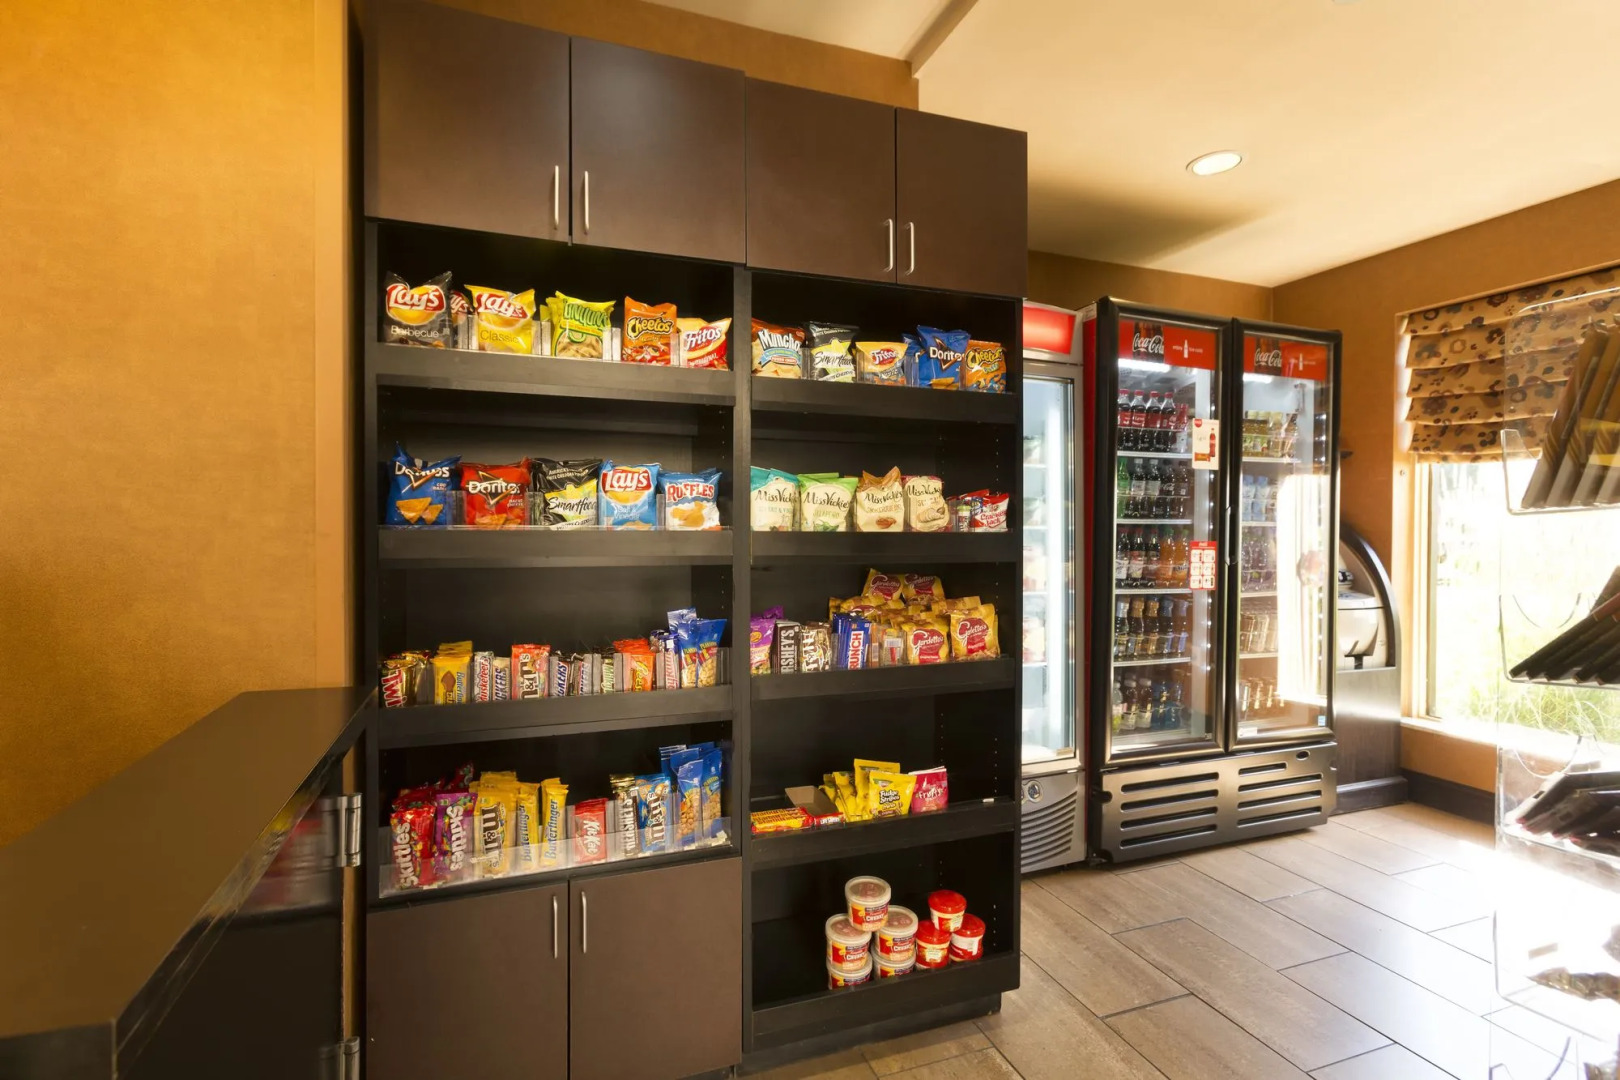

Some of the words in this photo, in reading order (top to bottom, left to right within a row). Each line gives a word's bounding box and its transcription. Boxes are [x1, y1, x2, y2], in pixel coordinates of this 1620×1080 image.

[389, 286, 440, 310] Lay's
[477, 294, 523, 318] Lay's
[390, 325, 440, 339] Barbecue
[479, 330, 520, 344] Classic
[626, 316, 674, 339] Cheetos
[684, 326, 723, 350] Fritos
[605, 469, 649, 492] Lay's
[548, 497, 597, 515] Smartfoo
[803, 491, 826, 506] Miss
[781, 629, 795, 674] RSHEY'S
[848, 632, 863, 670] RUNCH
[381, 668, 403, 708] TWI
[446, 805, 467, 872] Skittles
[392, 822, 420, 889] Skittles
